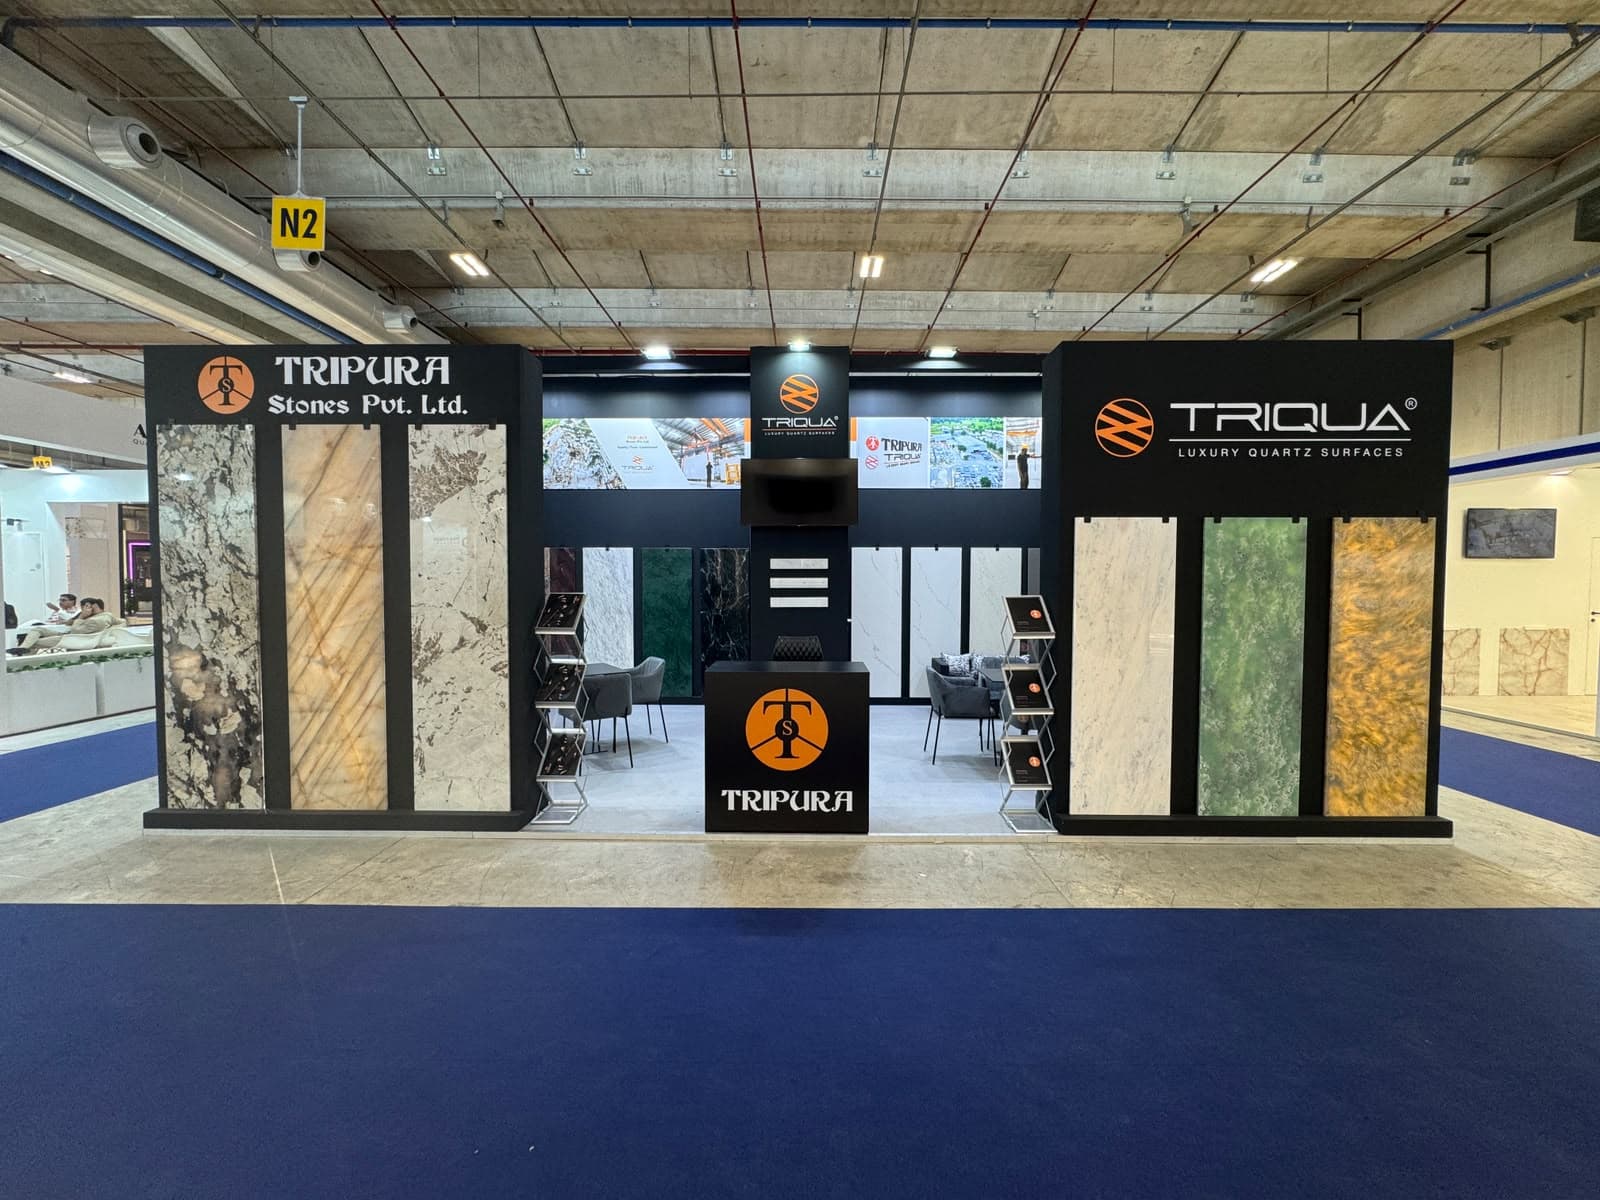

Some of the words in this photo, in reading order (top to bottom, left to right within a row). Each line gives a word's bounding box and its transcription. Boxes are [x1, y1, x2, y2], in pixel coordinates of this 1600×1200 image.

[281, 208, 317, 238] N2
[274, 356, 450, 386] TRIPURA
[268, 394, 350, 415] Stones
[362, 394, 413, 415] Pvt.
[421, 394, 468, 415] Ltd.
[1178, 447, 1240, 457] LUXURY
[1248, 447, 1312, 458] QUARTZ
[1321, 447, 1404, 457] SURFACES
[720, 789, 853, 812] TRIPURA
